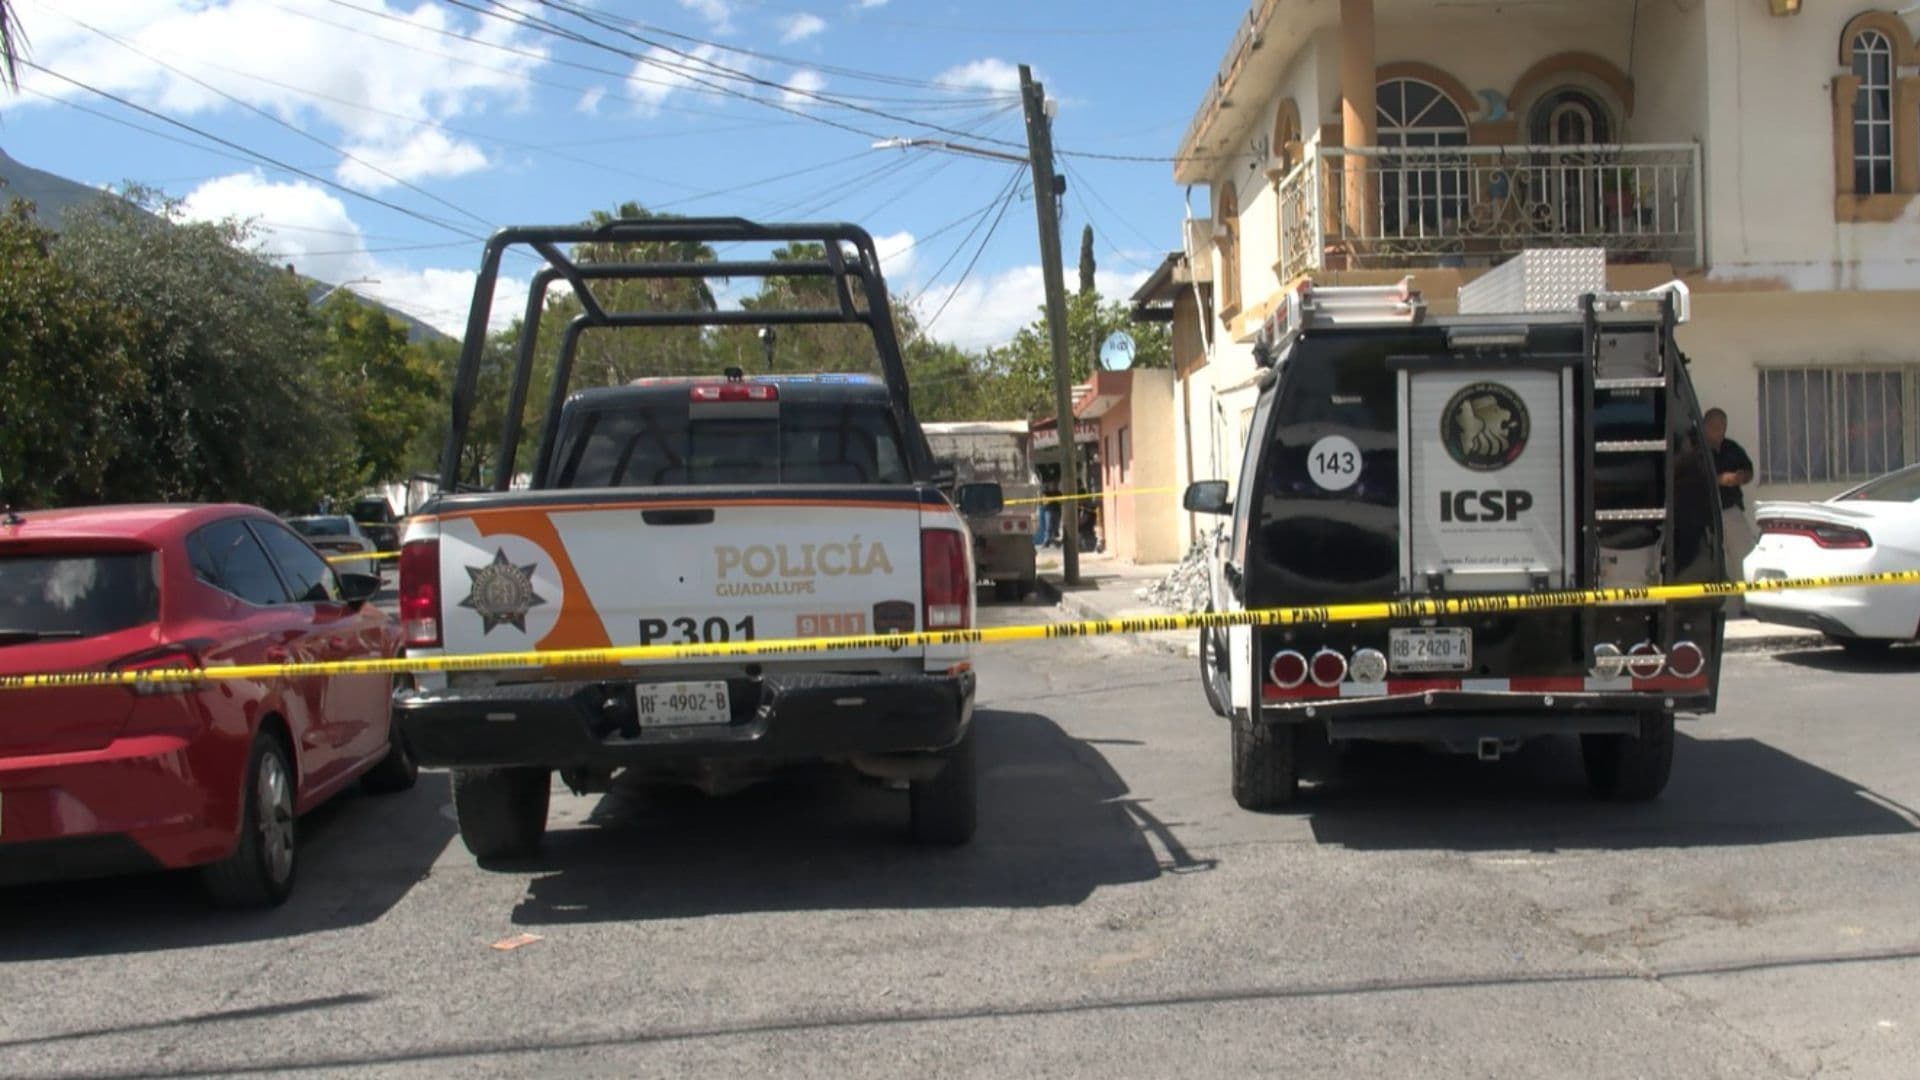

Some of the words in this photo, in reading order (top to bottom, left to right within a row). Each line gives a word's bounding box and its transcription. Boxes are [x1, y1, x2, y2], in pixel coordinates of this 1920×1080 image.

[1316, 451, 1354, 474] 143
[1440, 490, 1533, 522] ICSP
[714, 534, 894, 579] POLICÍA
[716, 580, 816, 597] GUADALUPE
[639, 616, 754, 647] P301
[800, 614, 861, 634] 911
[1394, 639, 1466, 657] RB-2420-A
[641, 692, 726, 714] RF-4902-B
